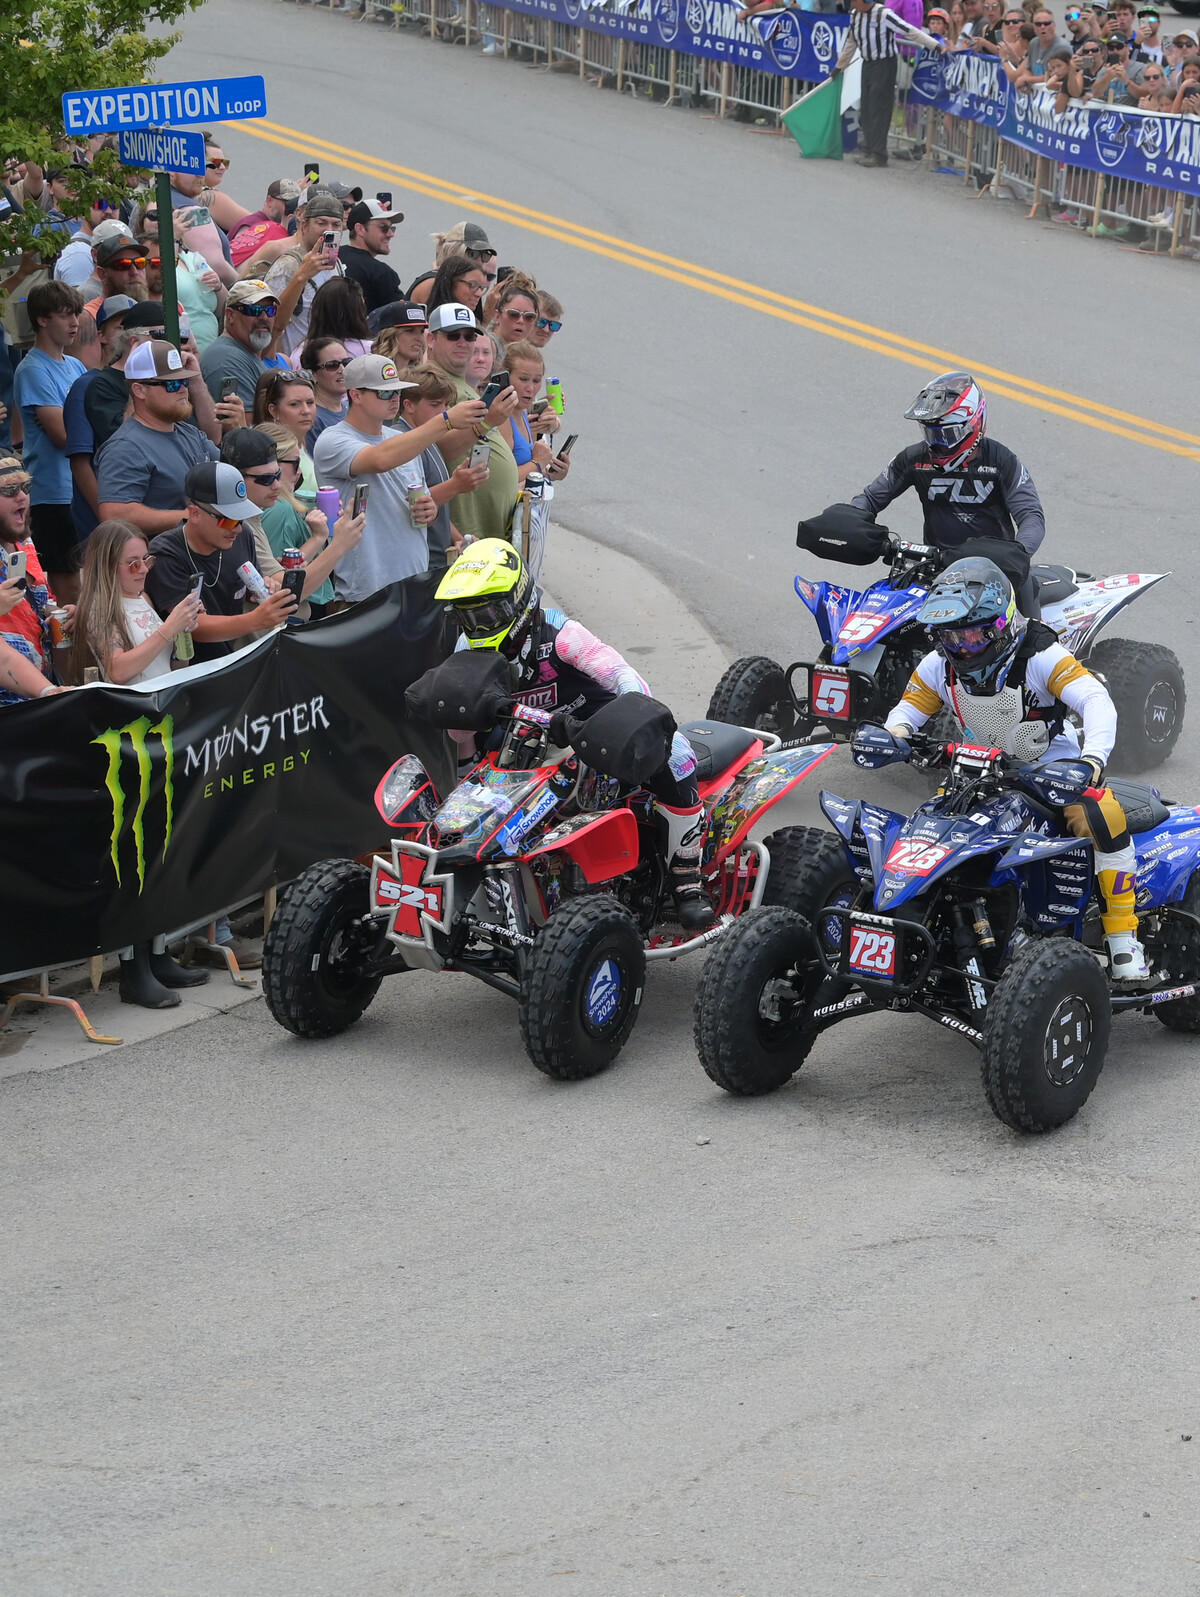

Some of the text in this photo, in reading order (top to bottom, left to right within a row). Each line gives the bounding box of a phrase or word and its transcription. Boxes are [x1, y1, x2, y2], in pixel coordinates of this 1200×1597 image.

[589, 14, 649, 34] RACING
[693, 36, 762, 60] RACING
[67, 86, 262, 128] EXPEDITION LOOP
[123, 130, 200, 169] SNOWSHOE DR
[1016, 124, 1081, 154] RACING
[927, 478, 995, 504] FLY
[868, 594, 889, 602] YAMAHA
[924, 609, 952, 620] FLY
[838, 617, 885, 641] 5
[814, 664, 847, 674] RATH
[815, 678, 850, 713] 5
[781, 735, 812, 749] OUSER
[956, 747, 991, 759] FASST
[203, 749, 312, 799] ENERGY
[1050, 781, 1075, 791] FOWLER
[521, 793, 557, 832] Snowshoe
[1001, 813, 1023, 832] YAMAHA
[920, 829, 940, 839] YAMAHA
[1023, 838, 1067, 847] GBC
[887, 841, 947, 871] 723
[378, 879, 440, 912] 521
[849, 910, 895, 927] RATH
[478, 920, 535, 946] LONE STAR RACIN
[826, 921, 842, 945] 2024
[849, 930, 895, 970] 723
[588, 982, 618, 1018] Snowshoe
[597, 994, 617, 1022] 2024
[813, 996, 863, 1018] HOUSER
[941, 1015, 984, 1042] HOUSE
